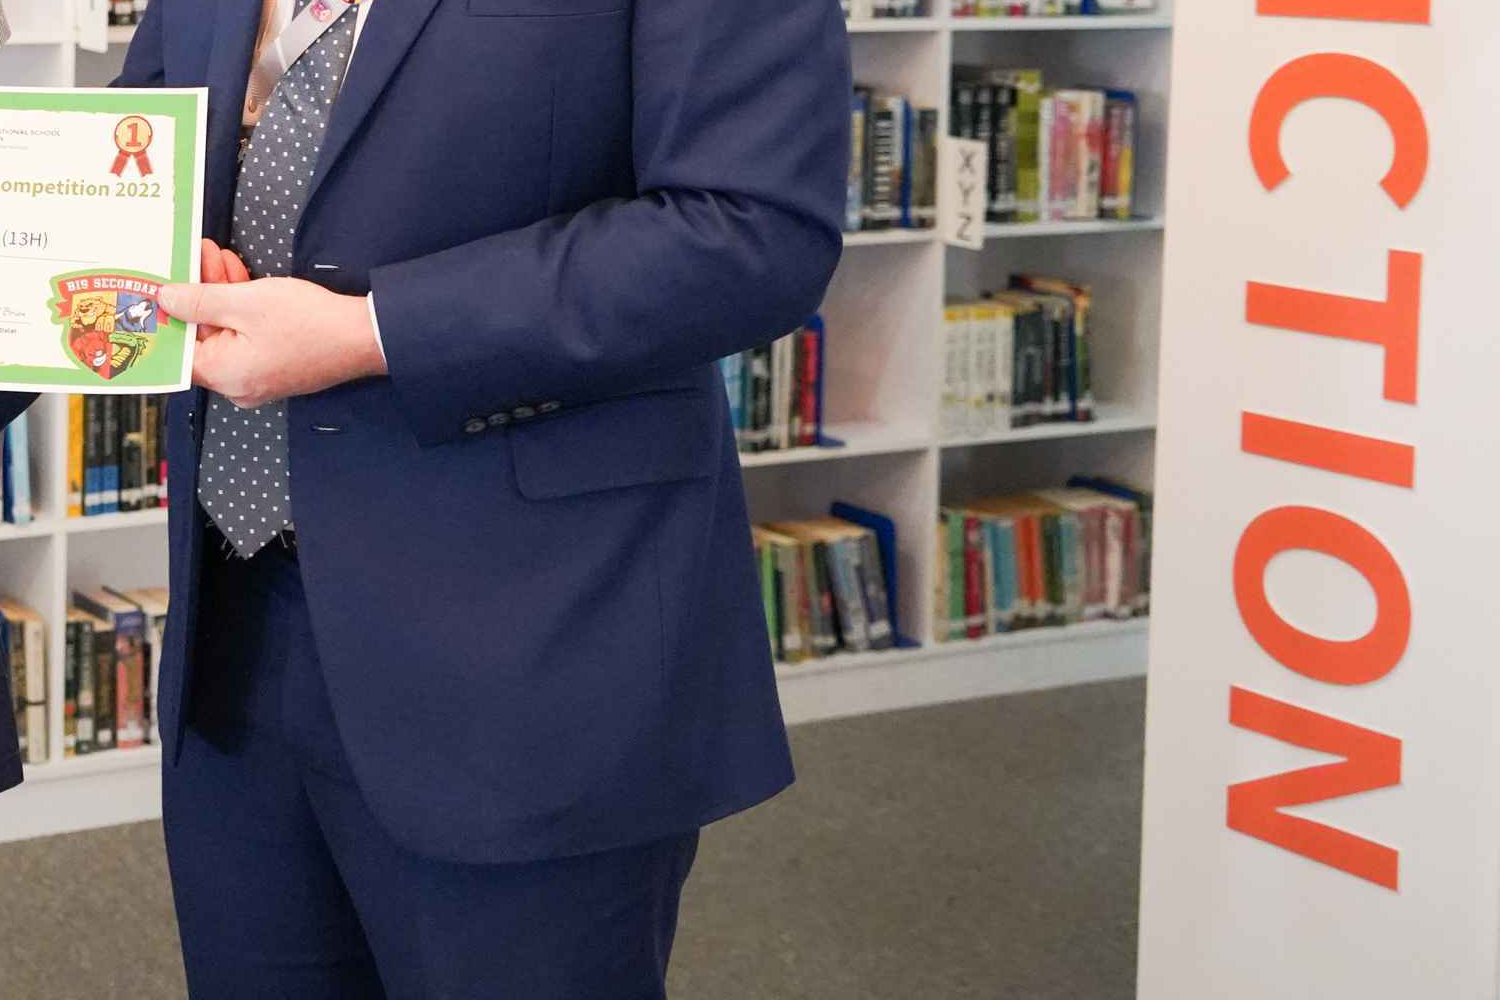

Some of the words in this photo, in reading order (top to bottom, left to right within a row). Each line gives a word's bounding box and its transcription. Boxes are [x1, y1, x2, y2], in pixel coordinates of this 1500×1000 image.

[30, 129, 61, 137] SCHOOL
[126, 122, 142, 147] 1
[958, 150, 977, 174] X
[115, 182, 161, 198] 2022
[958, 182, 977, 205] Y
[956, 213, 973, 241] Z
[2, 230, 48, 249] (13H)
